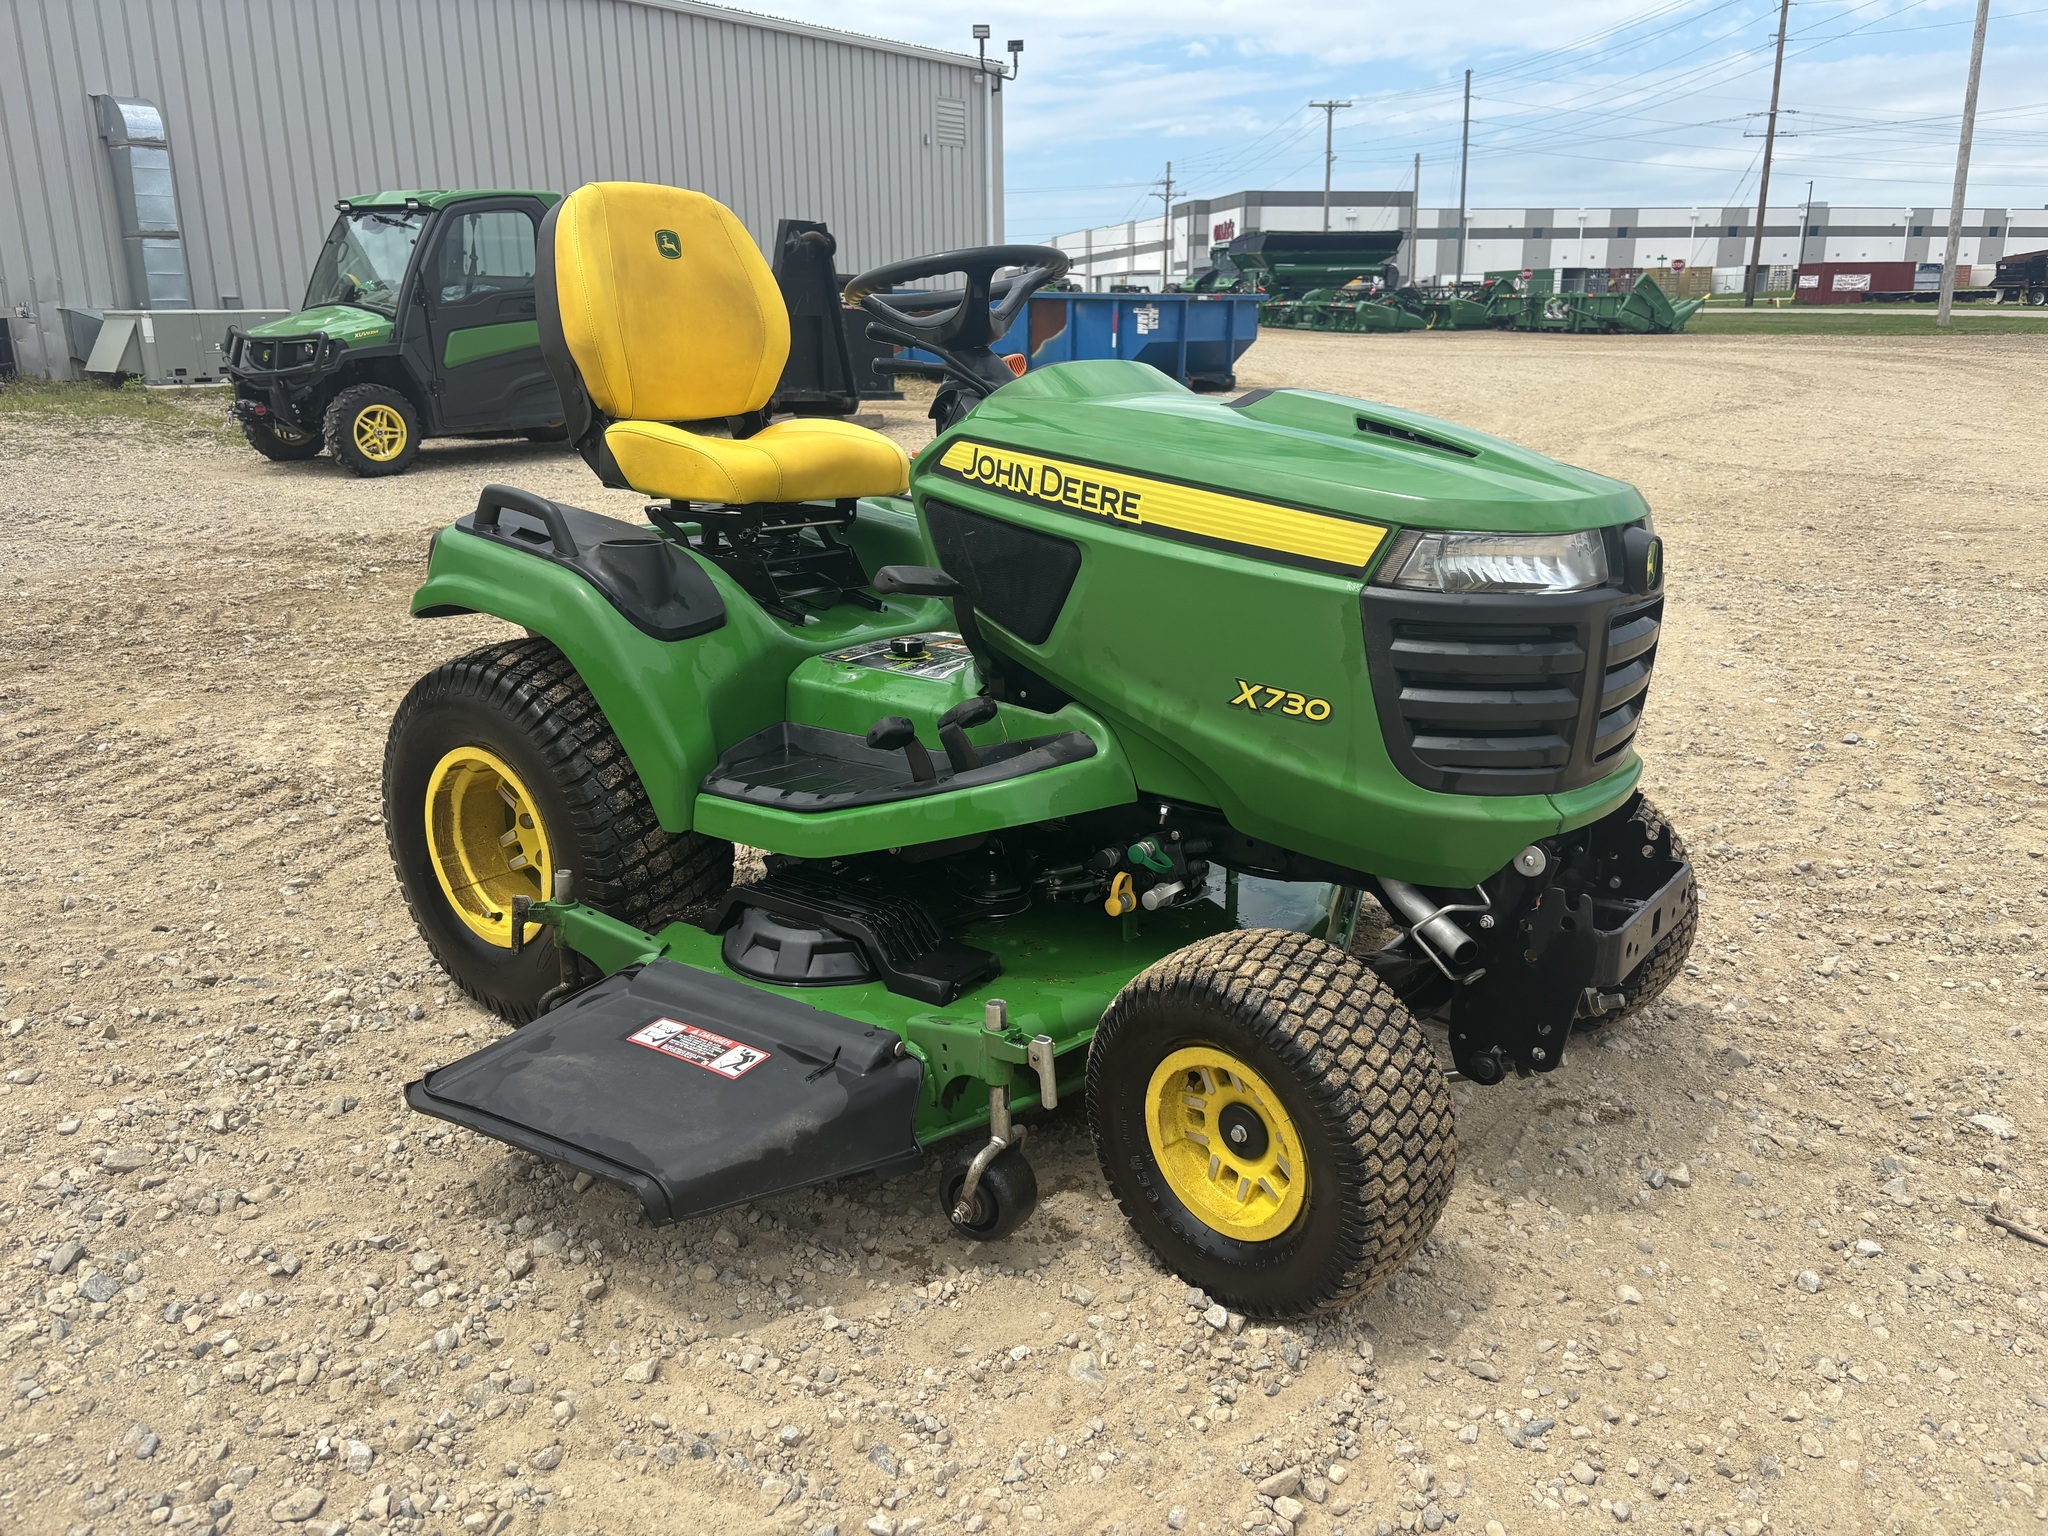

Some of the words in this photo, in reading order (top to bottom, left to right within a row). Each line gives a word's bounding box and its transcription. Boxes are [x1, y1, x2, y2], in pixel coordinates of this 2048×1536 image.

[963, 447, 1034, 492] JOHN
[1040, 464, 1142, 520] DEERE
[1227, 678, 1333, 722] X730
[697, 1030, 734, 1046] DANGER
